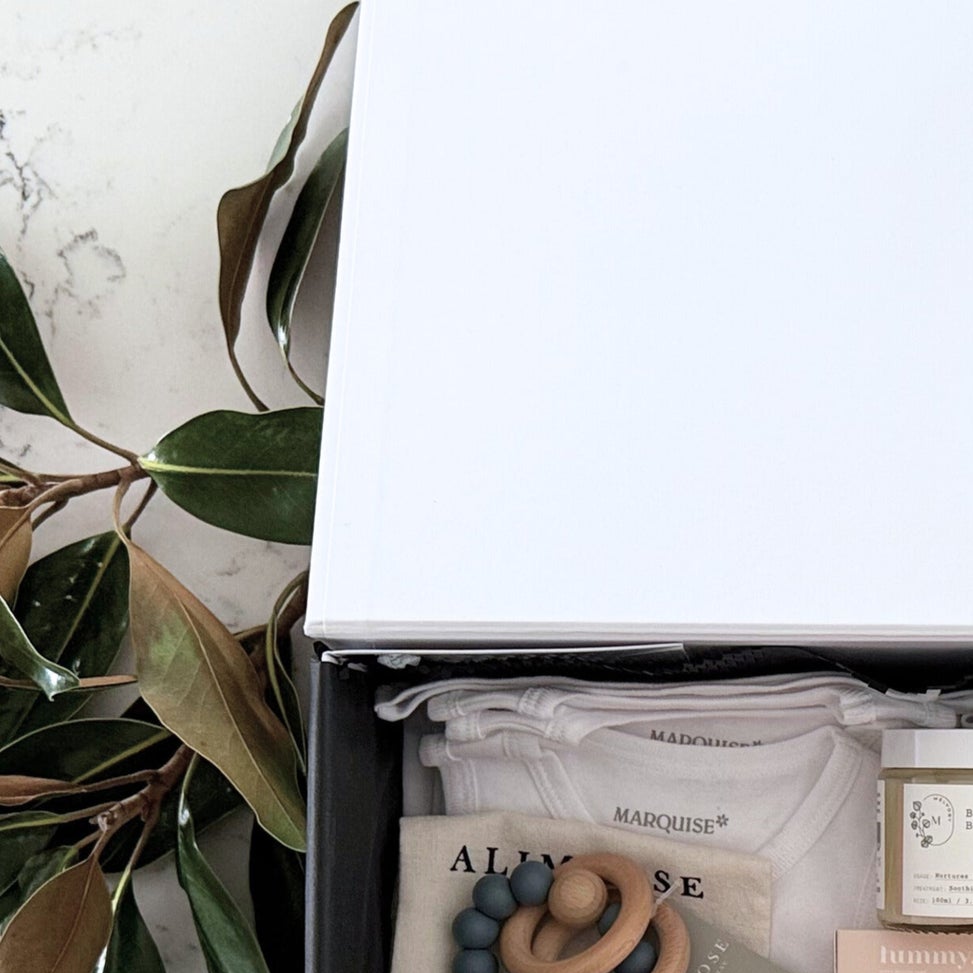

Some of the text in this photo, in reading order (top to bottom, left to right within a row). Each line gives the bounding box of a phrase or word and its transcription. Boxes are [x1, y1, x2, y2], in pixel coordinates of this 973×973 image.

[650, 729, 750, 748] MARQU
[612, 806, 716, 834] MARQUISE
[450, 845, 704, 899] ALISE
